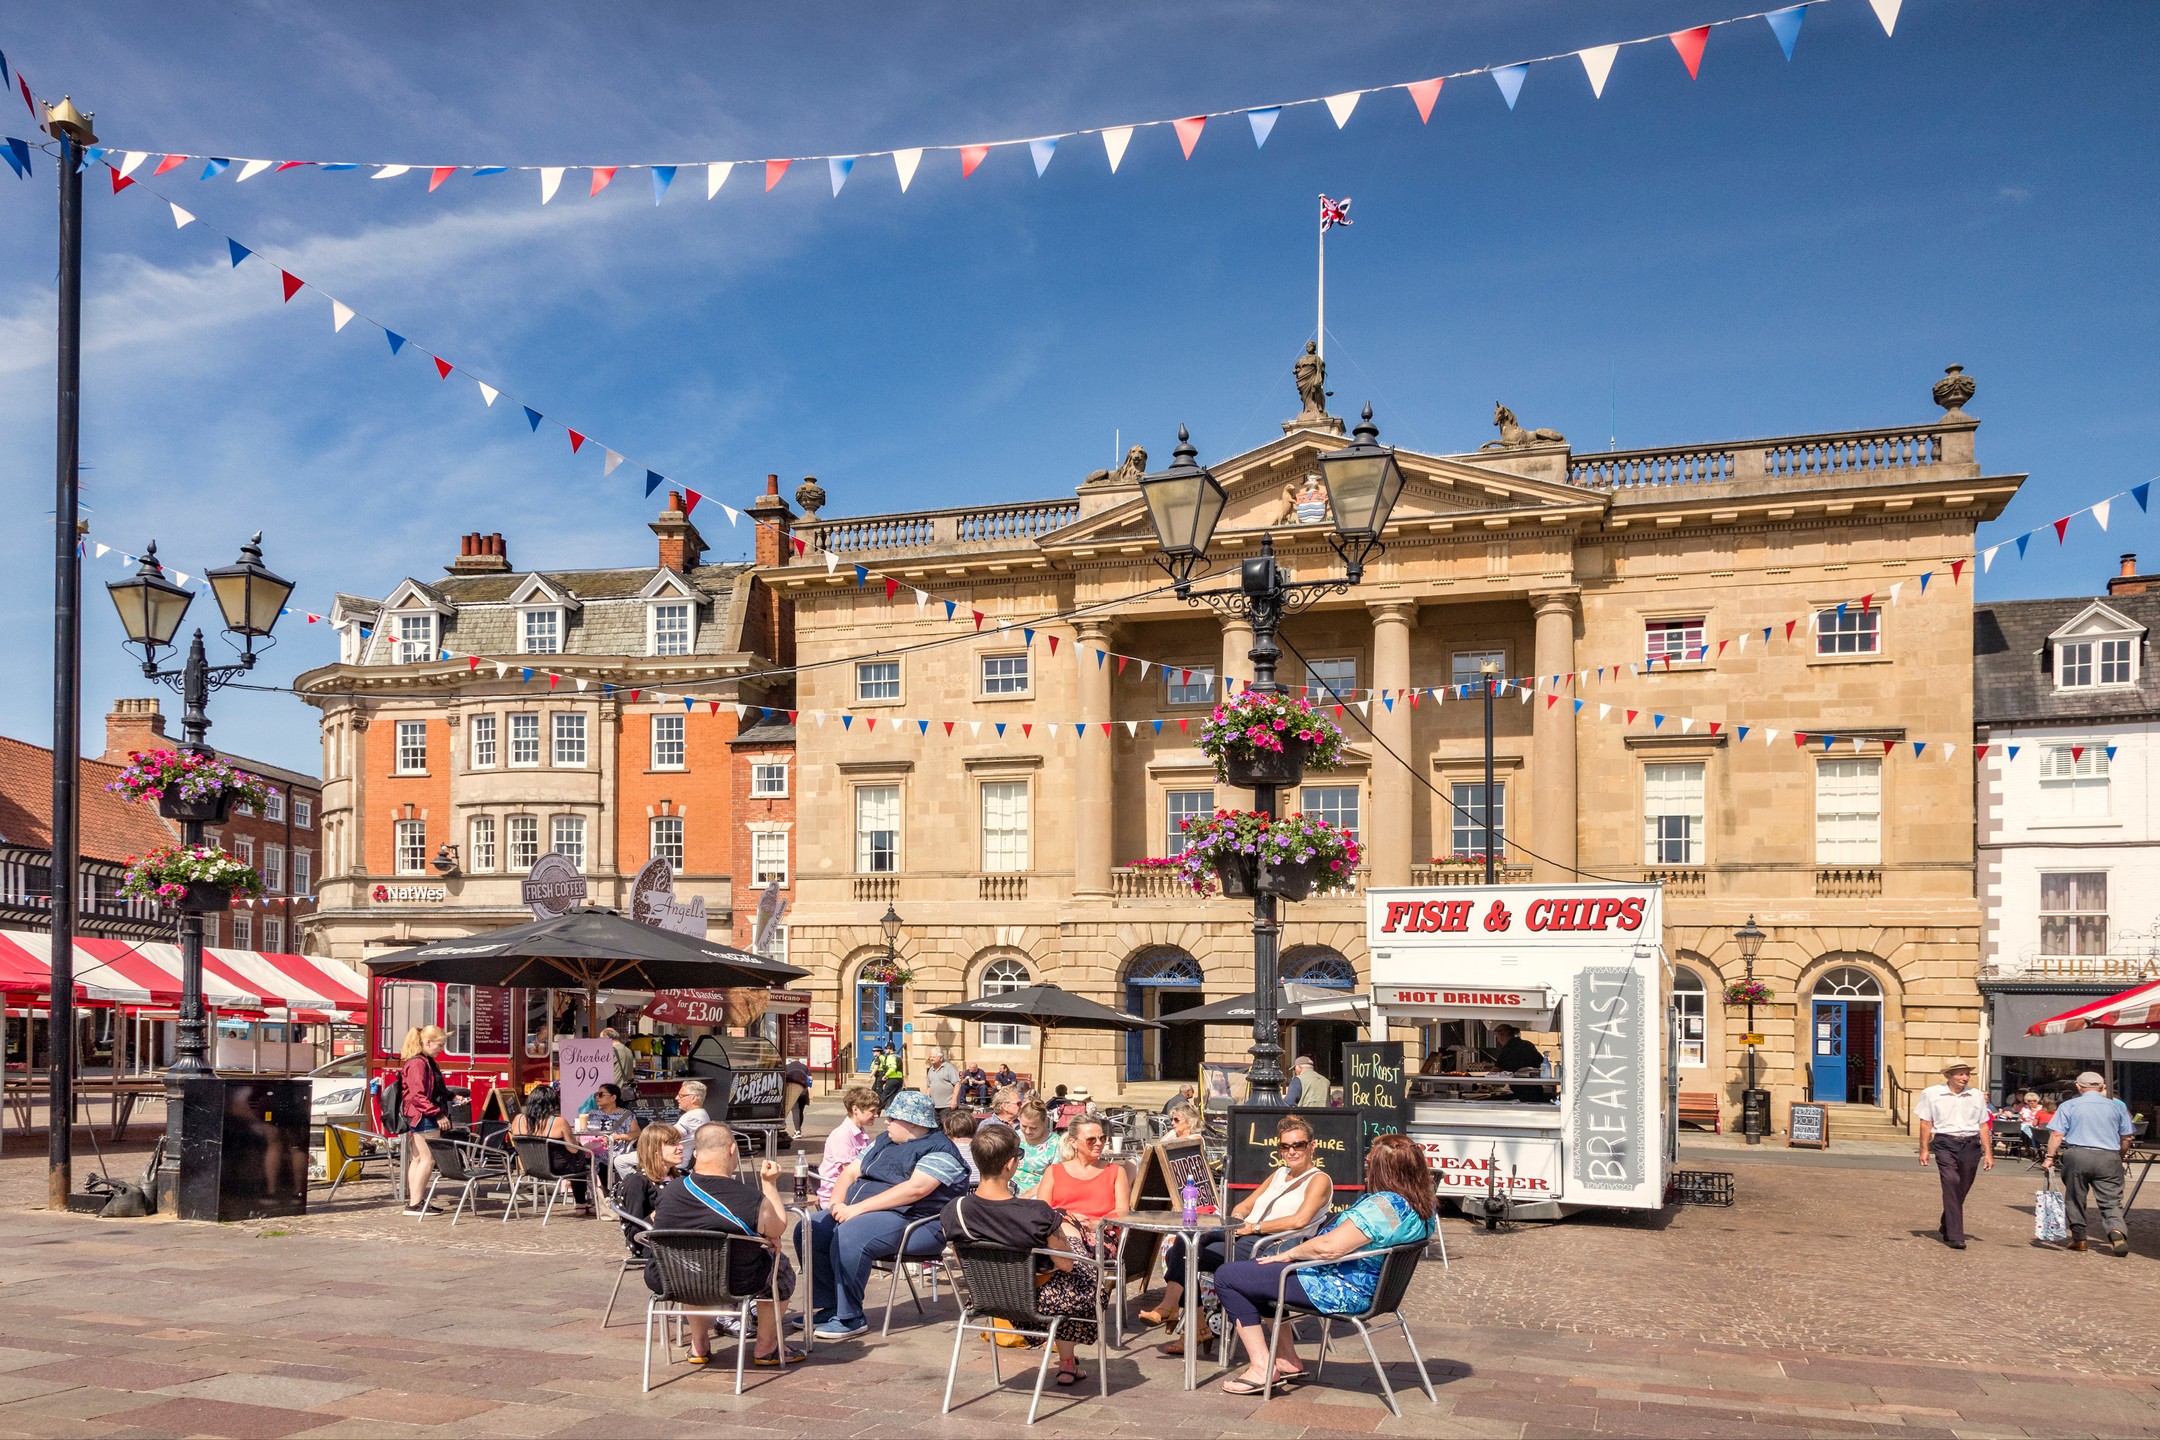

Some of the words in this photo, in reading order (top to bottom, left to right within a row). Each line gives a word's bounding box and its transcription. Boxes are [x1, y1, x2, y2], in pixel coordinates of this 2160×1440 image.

[526, 883, 553, 900] FRESH
[555, 881, 584, 897] COFFEE
[1381, 900, 1474, 933] FISH
[1483, 899, 1512, 933] &
[1525, 897, 1646, 932] CHIPS
[2037, 958, 2093, 977] THE
[2103, 958, 2160, 977] BEA
[690, 988, 724, 1000] Toasties
[769, 993, 801, 1002] mericano
[1398, 991, 1438, 1003] HOT
[1443, 992, 1521, 1006] DRINKS
[677, 1000, 689, 1008] for
[686, 1001, 724, 1022] £3.00
[561, 1045, 611, 1065] Sherbet
[575, 1066, 599, 1088] 99
[1351, 1053, 1371, 1078] HOT
[1372, 1052, 1400, 1084] ROAST
[1586, 973, 1633, 1181] BREAKFAST
[738, 1074, 748, 1085] DO
[749, 1072, 763, 1082] YOU
[733, 1072, 777, 1105] SCREAM
[1351, 1081, 1371, 1106] PORK
[1374, 1084, 1397, 1108] ROLL
[750, 1095, 762, 1104] ICE
[761, 1095, 783, 1104] CREAM
[1169, 1155, 1210, 1189] BURGER
[1427, 1156, 1502, 1172] TEAK
[1443, 1174, 1551, 1191] URGER
